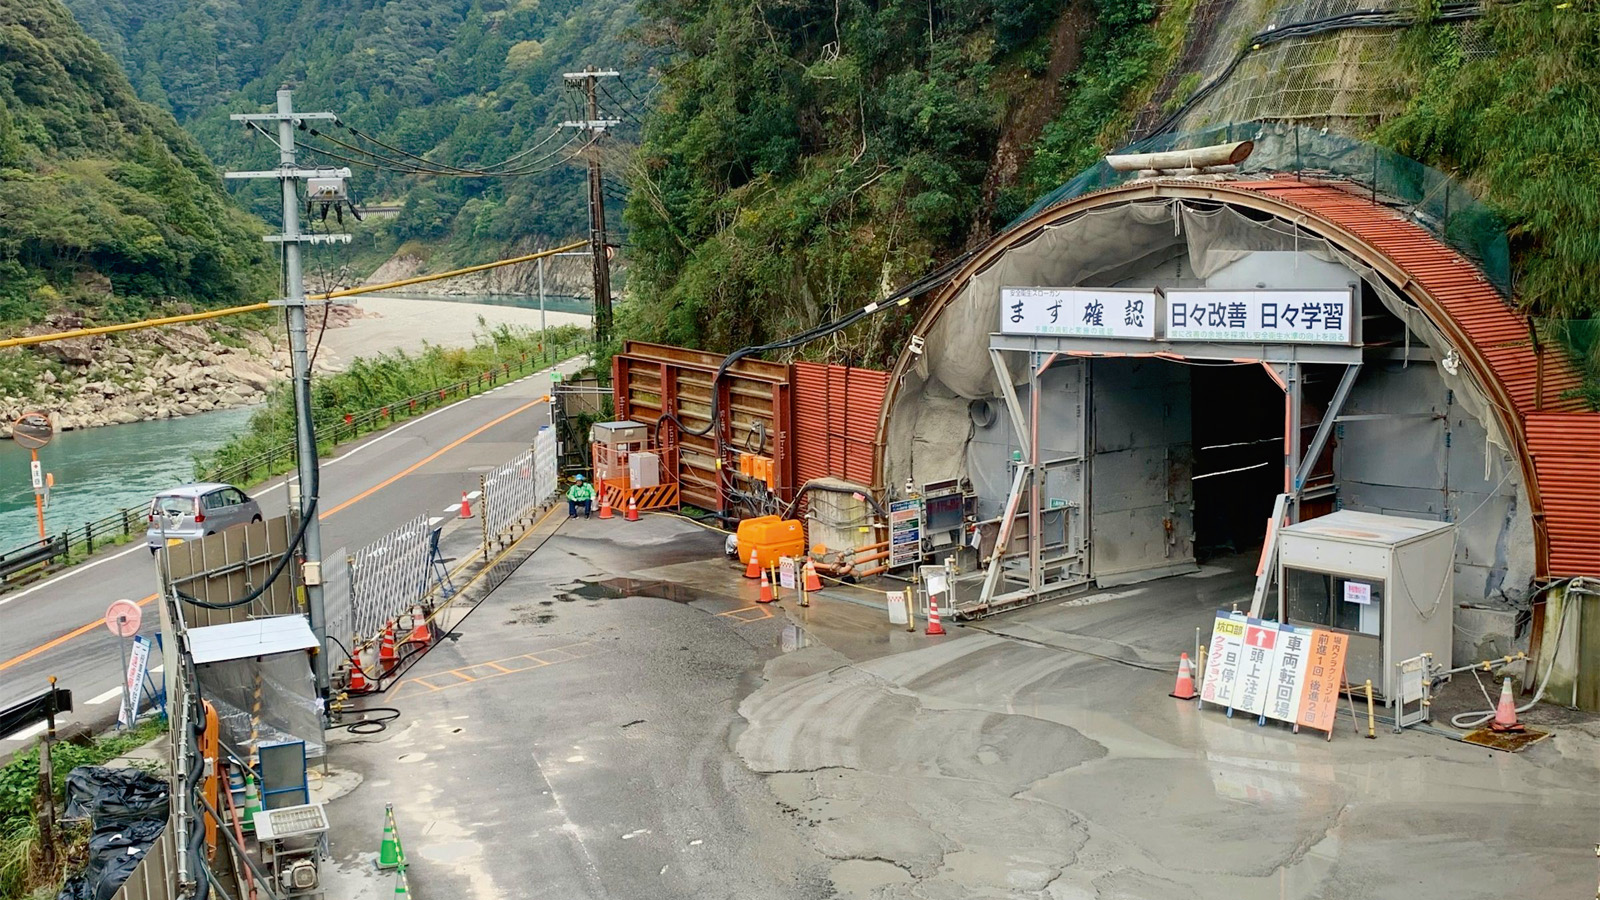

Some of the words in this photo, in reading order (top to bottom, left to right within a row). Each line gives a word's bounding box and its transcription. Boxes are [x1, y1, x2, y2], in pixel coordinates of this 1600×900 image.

[1010, 299, 1145, 327] まず確認
[1172, 302, 1247, 329] 日々改善
[1261, 302, 1344, 330] 日々学習
[1216, 621, 1244, 636] 坑口部
[1217, 641, 1240, 700] 一旦停止
[1240, 647, 1265, 711] 頭上注意
[1273, 635, 1303, 719] 車両転回場
